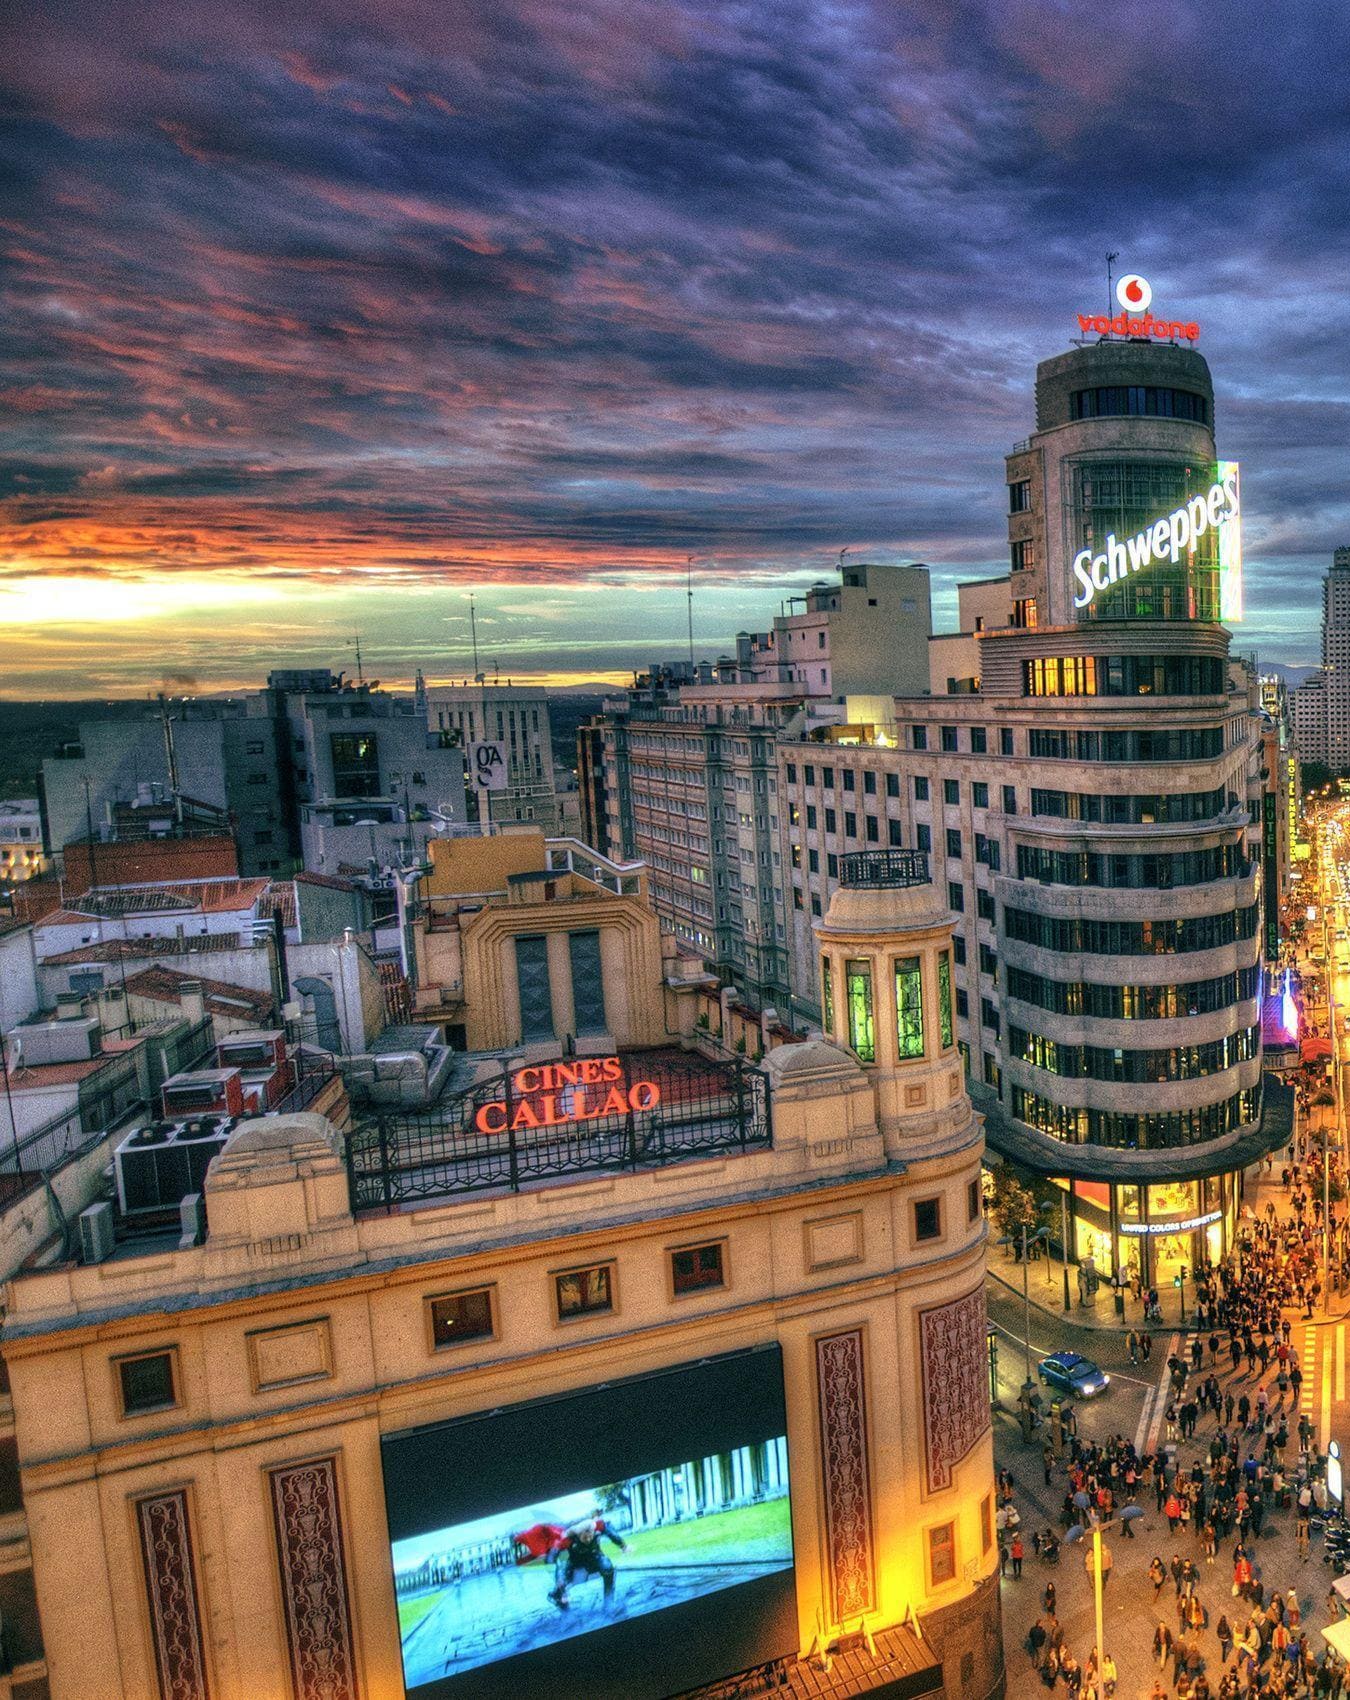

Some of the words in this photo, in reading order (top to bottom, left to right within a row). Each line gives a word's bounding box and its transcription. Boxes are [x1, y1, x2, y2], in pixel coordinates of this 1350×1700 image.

[1077, 312, 1200, 340] vodafone
[1073, 474, 1240, 609] Schweppes
[1266, 796, 1275, 857] HOTEL
[1268, 922, 1277, 957] REX
[515, 1056, 623, 1093] CINES
[476, 1081, 661, 1135] CALLAO
[1121, 1223, 1148, 1233] UNITED
[1149, 1222, 1180, 1233] COLORS
